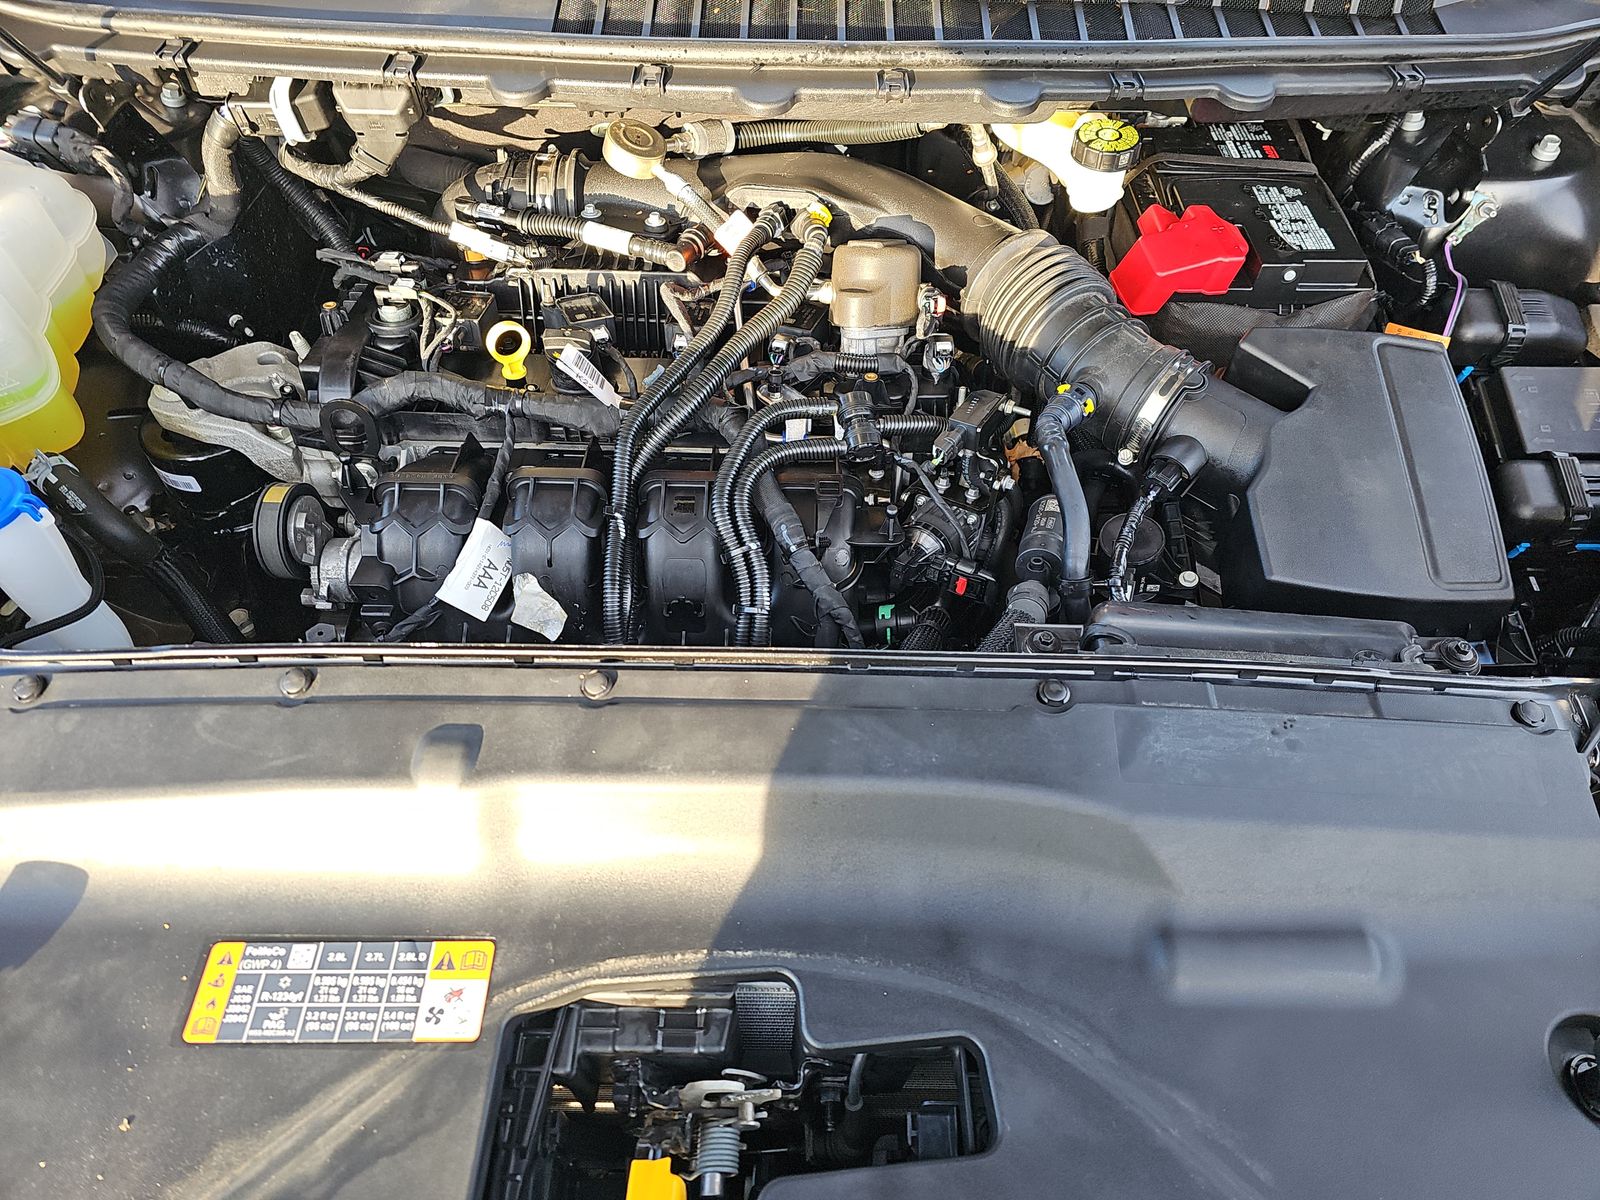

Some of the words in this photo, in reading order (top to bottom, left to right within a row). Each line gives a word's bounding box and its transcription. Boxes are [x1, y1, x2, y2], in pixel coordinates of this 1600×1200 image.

[472, 558, 498, 589] AAA
[364, 952, 385, 962] 2.7L
[418, 952, 428, 962] D
[239, 958, 270, 970] (GWP
[270, 958, 283, 970] 4)
